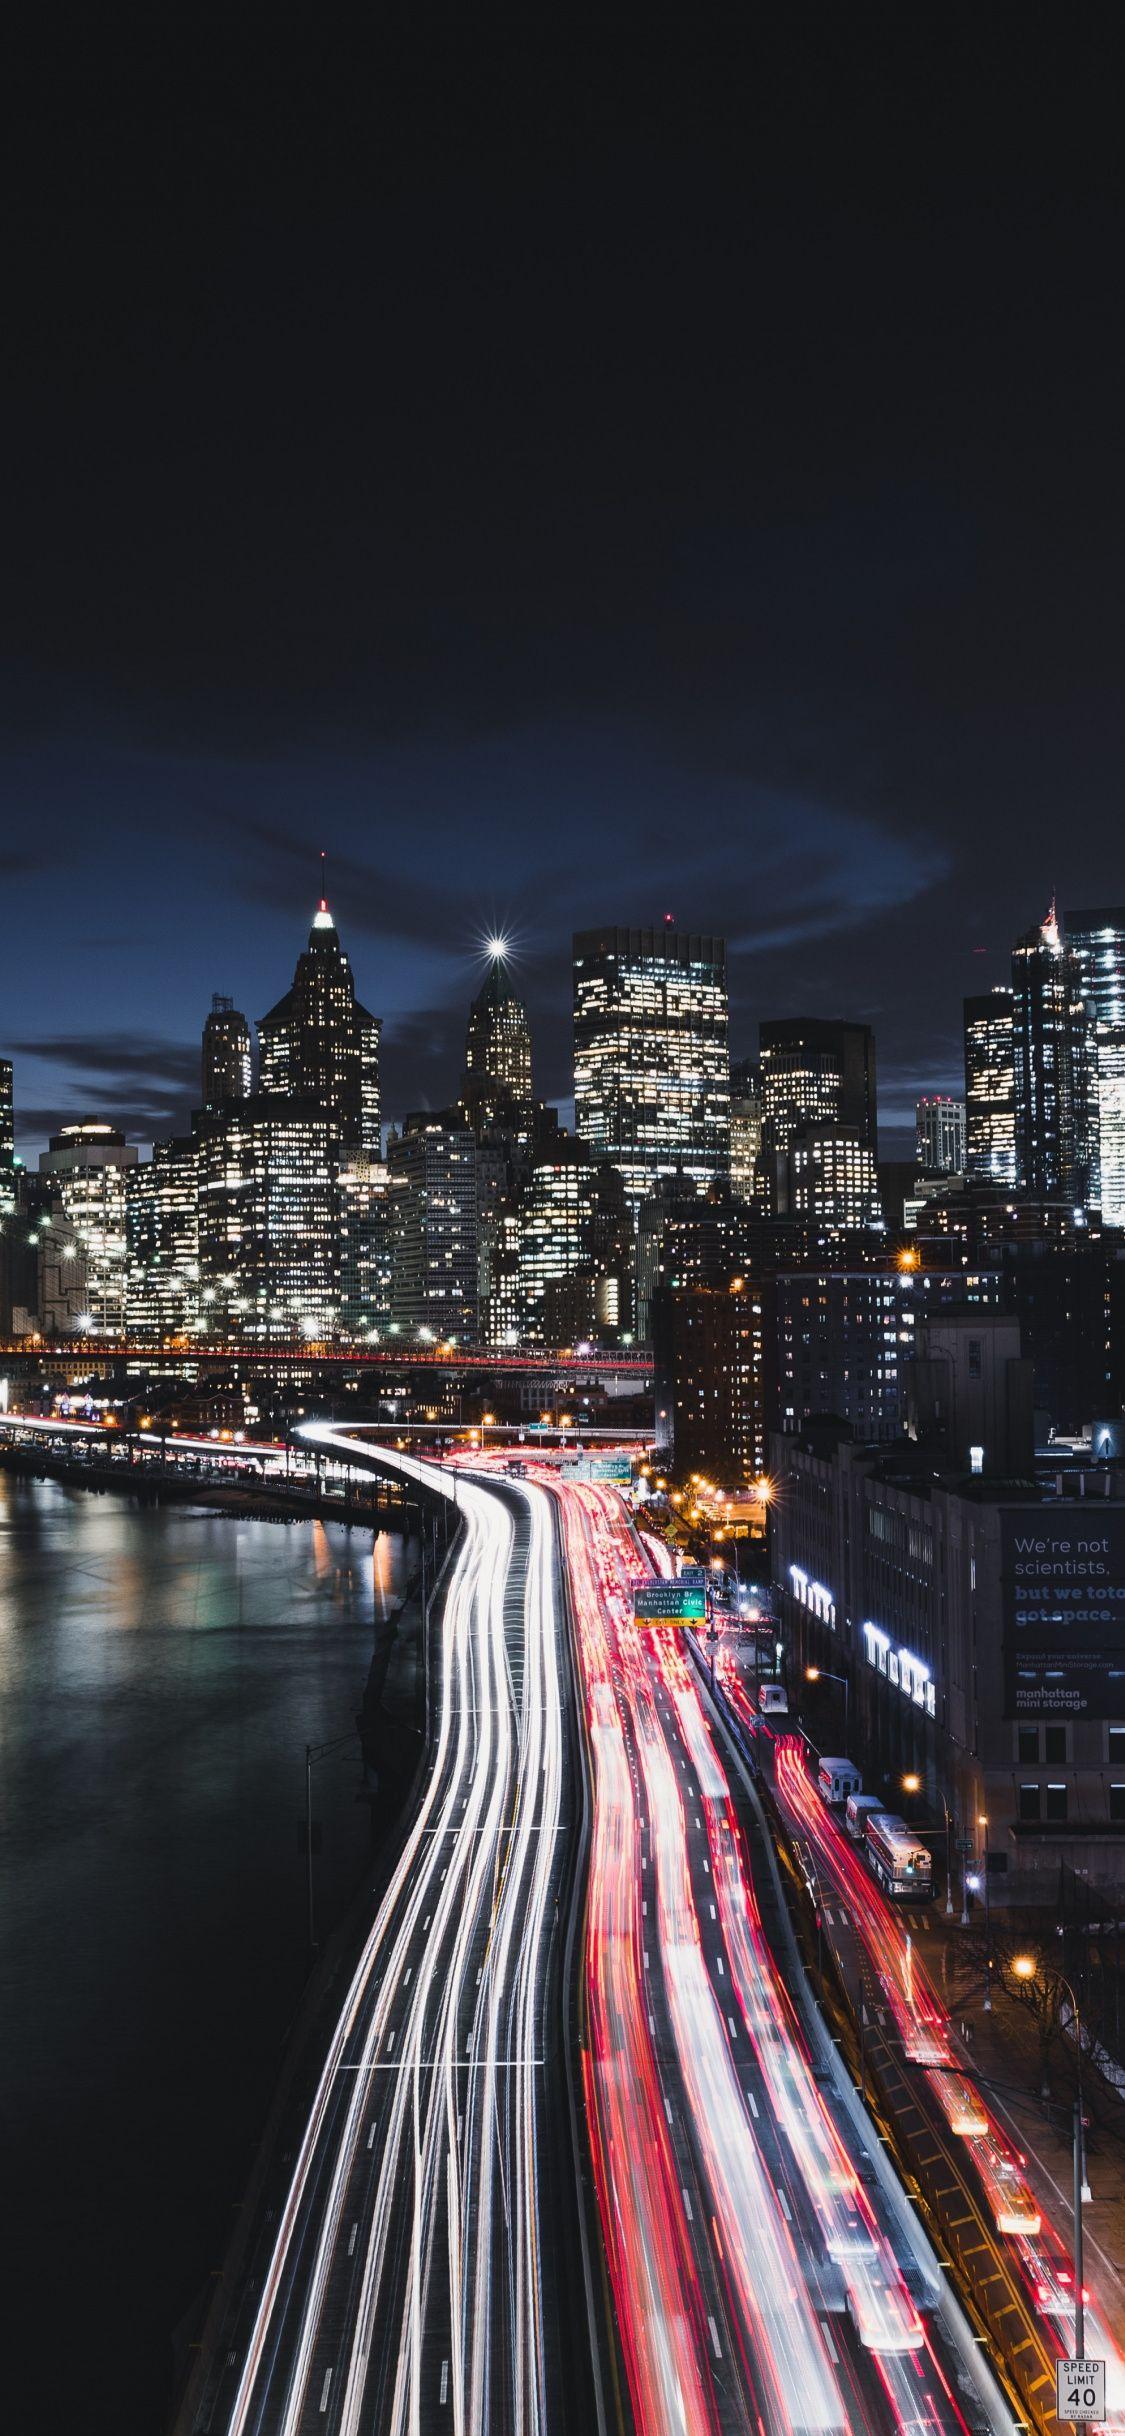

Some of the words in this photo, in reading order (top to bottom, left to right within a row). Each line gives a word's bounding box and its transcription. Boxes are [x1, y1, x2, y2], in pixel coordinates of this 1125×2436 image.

[1014, 1538, 1071, 1553] We're
[1077, 1538, 1109, 1553] not
[646, 1591, 681, 1599] Brooklyn
[1015, 1585, 1050, 1600] but
[1053, 1587, 1082, 1600] we
[1015, 1608, 1047, 1626] got
[1052, 1609, 1116, 1625] space.
[1016, 1685, 1080, 1698] manhattan
[1016, 1698, 1040, 1708] mini
[1042, 1699, 1088, 1710] storage
[1063, 2362, 1099, 2372] SPEED
[1067, 2375, 1095, 2385] LIMIT
[1067, 2388, 1096, 2407] 40
